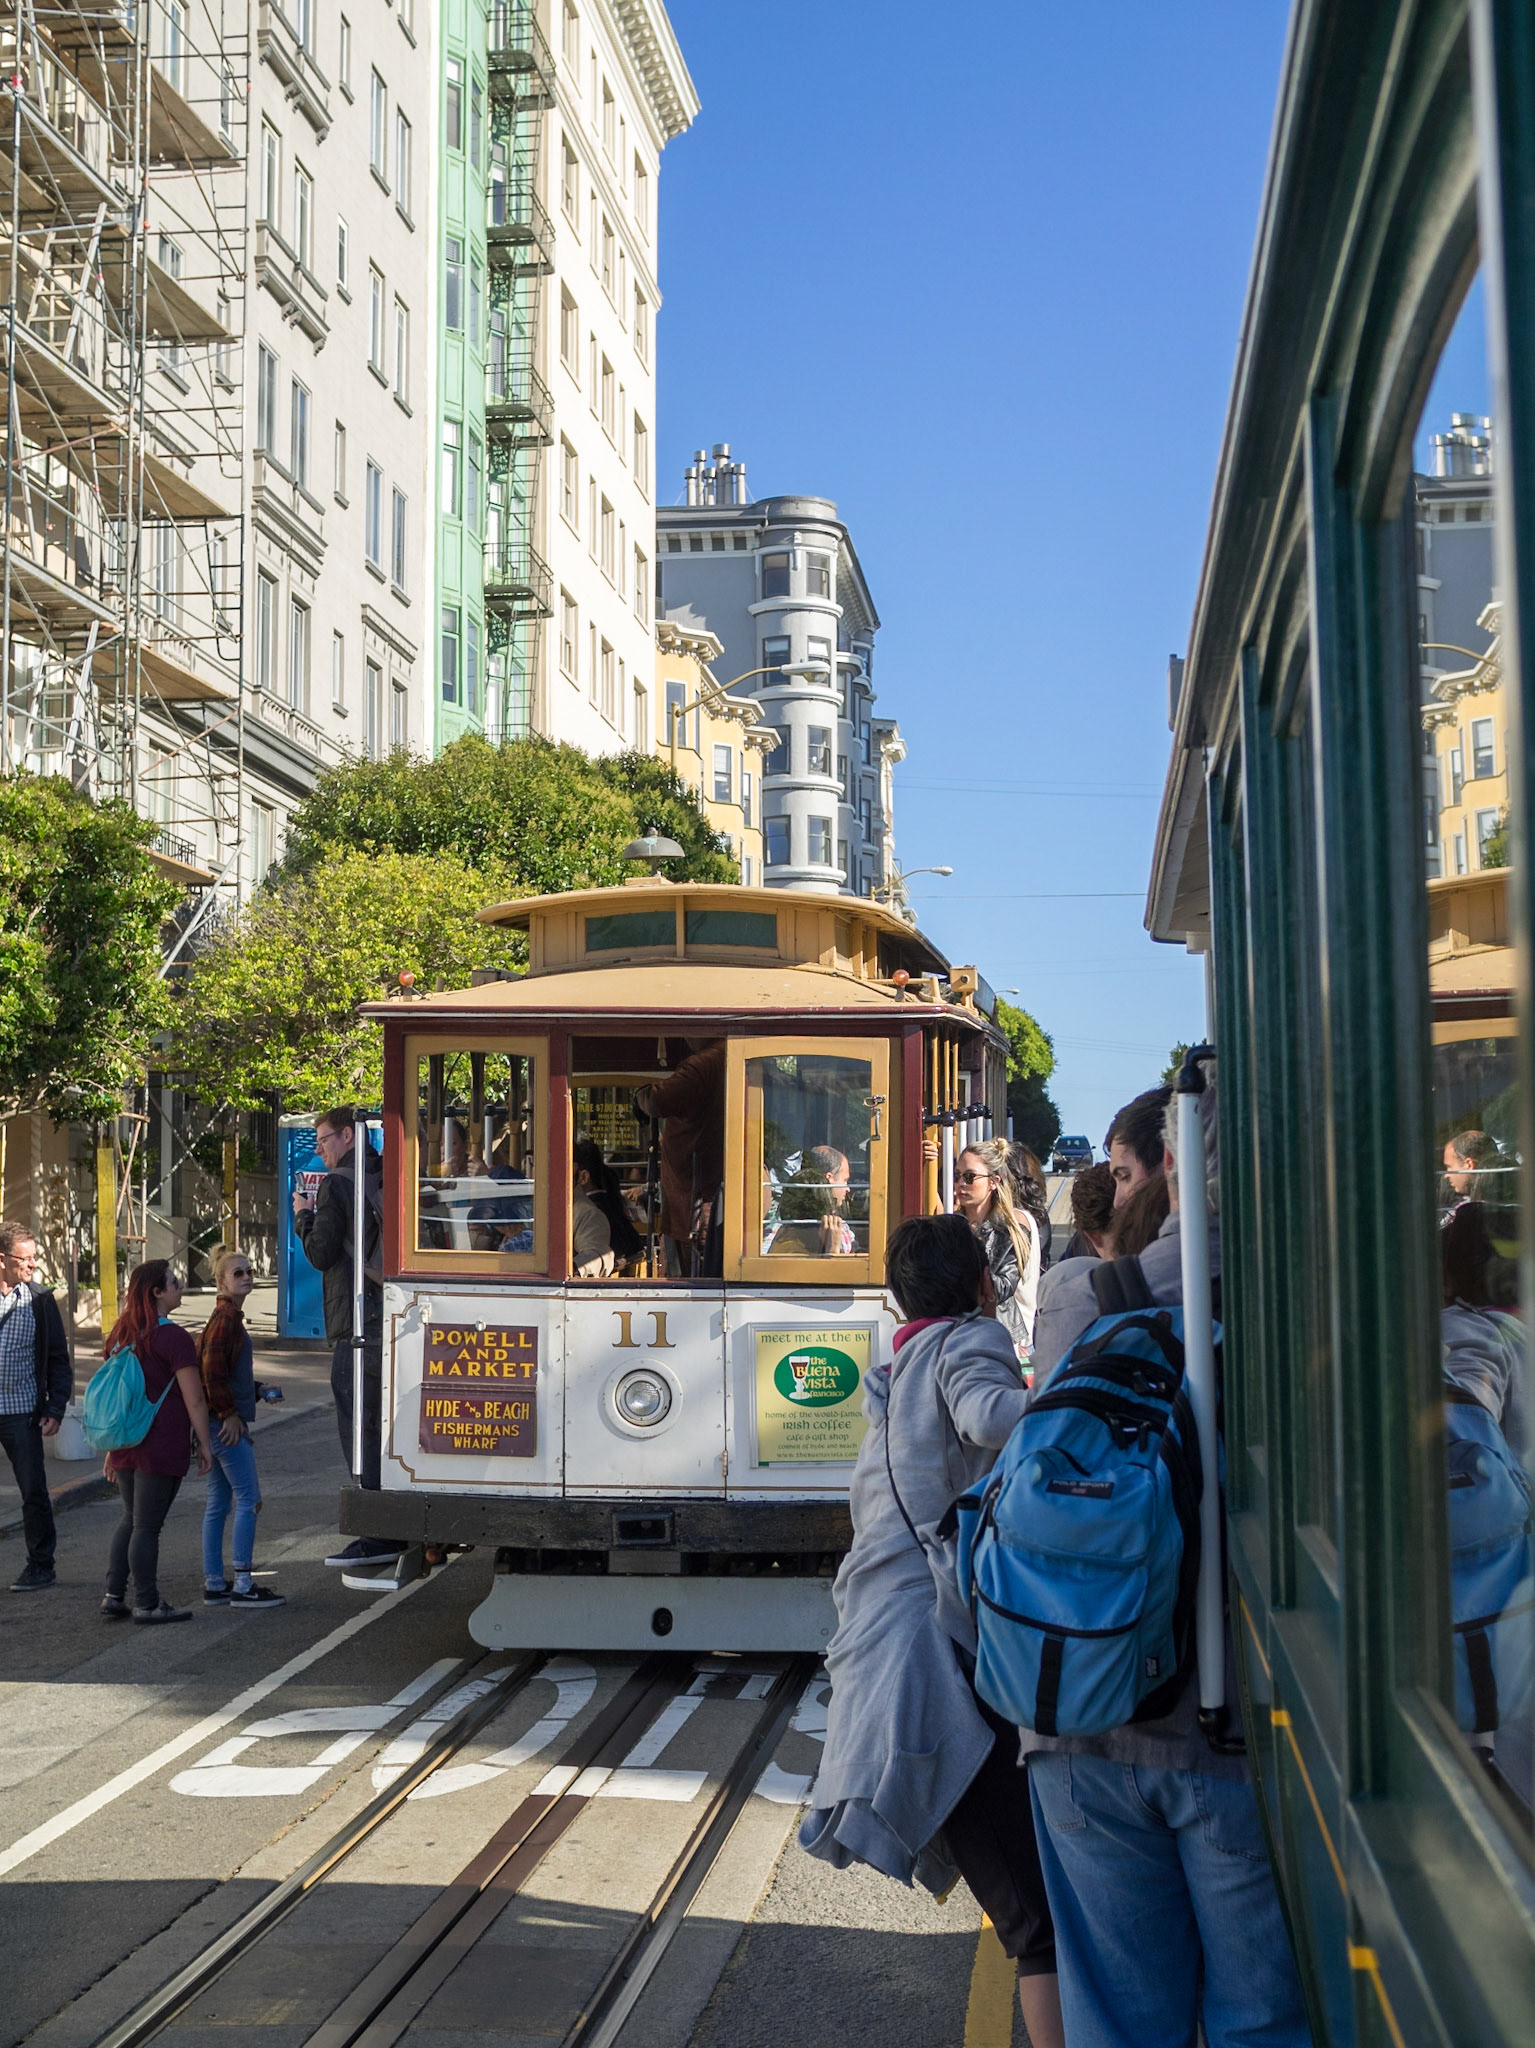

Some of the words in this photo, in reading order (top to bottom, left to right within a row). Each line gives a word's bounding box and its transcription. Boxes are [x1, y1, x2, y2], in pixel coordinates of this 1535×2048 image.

[612, 1311, 676, 1347] 11
[432, 1329, 532, 1348] POWELL
[761, 1333, 791, 1343] meet
[795, 1334, 813, 1342] me
[816, 1333, 827, 1342] at
[831, 1332, 851, 1342] the
[457, 1348, 508, 1361] AND
[810, 1356, 827, 1365] the
[429, 1360, 535, 1378] MARKET
[425, 1399, 461, 1418] HYDE
[465, 1401, 481, 1418] AND
[484, 1401, 530, 1420] BEACH
[765, 1411, 786, 1419] home
[788, 1411, 796, 1419] of
[433, 1422, 520, 1437] FISHERMANS
[813, 1420, 852, 1430] coffee
[453, 1436, 499, 1450] WHARF
[829, 1433, 849, 1442] shop
